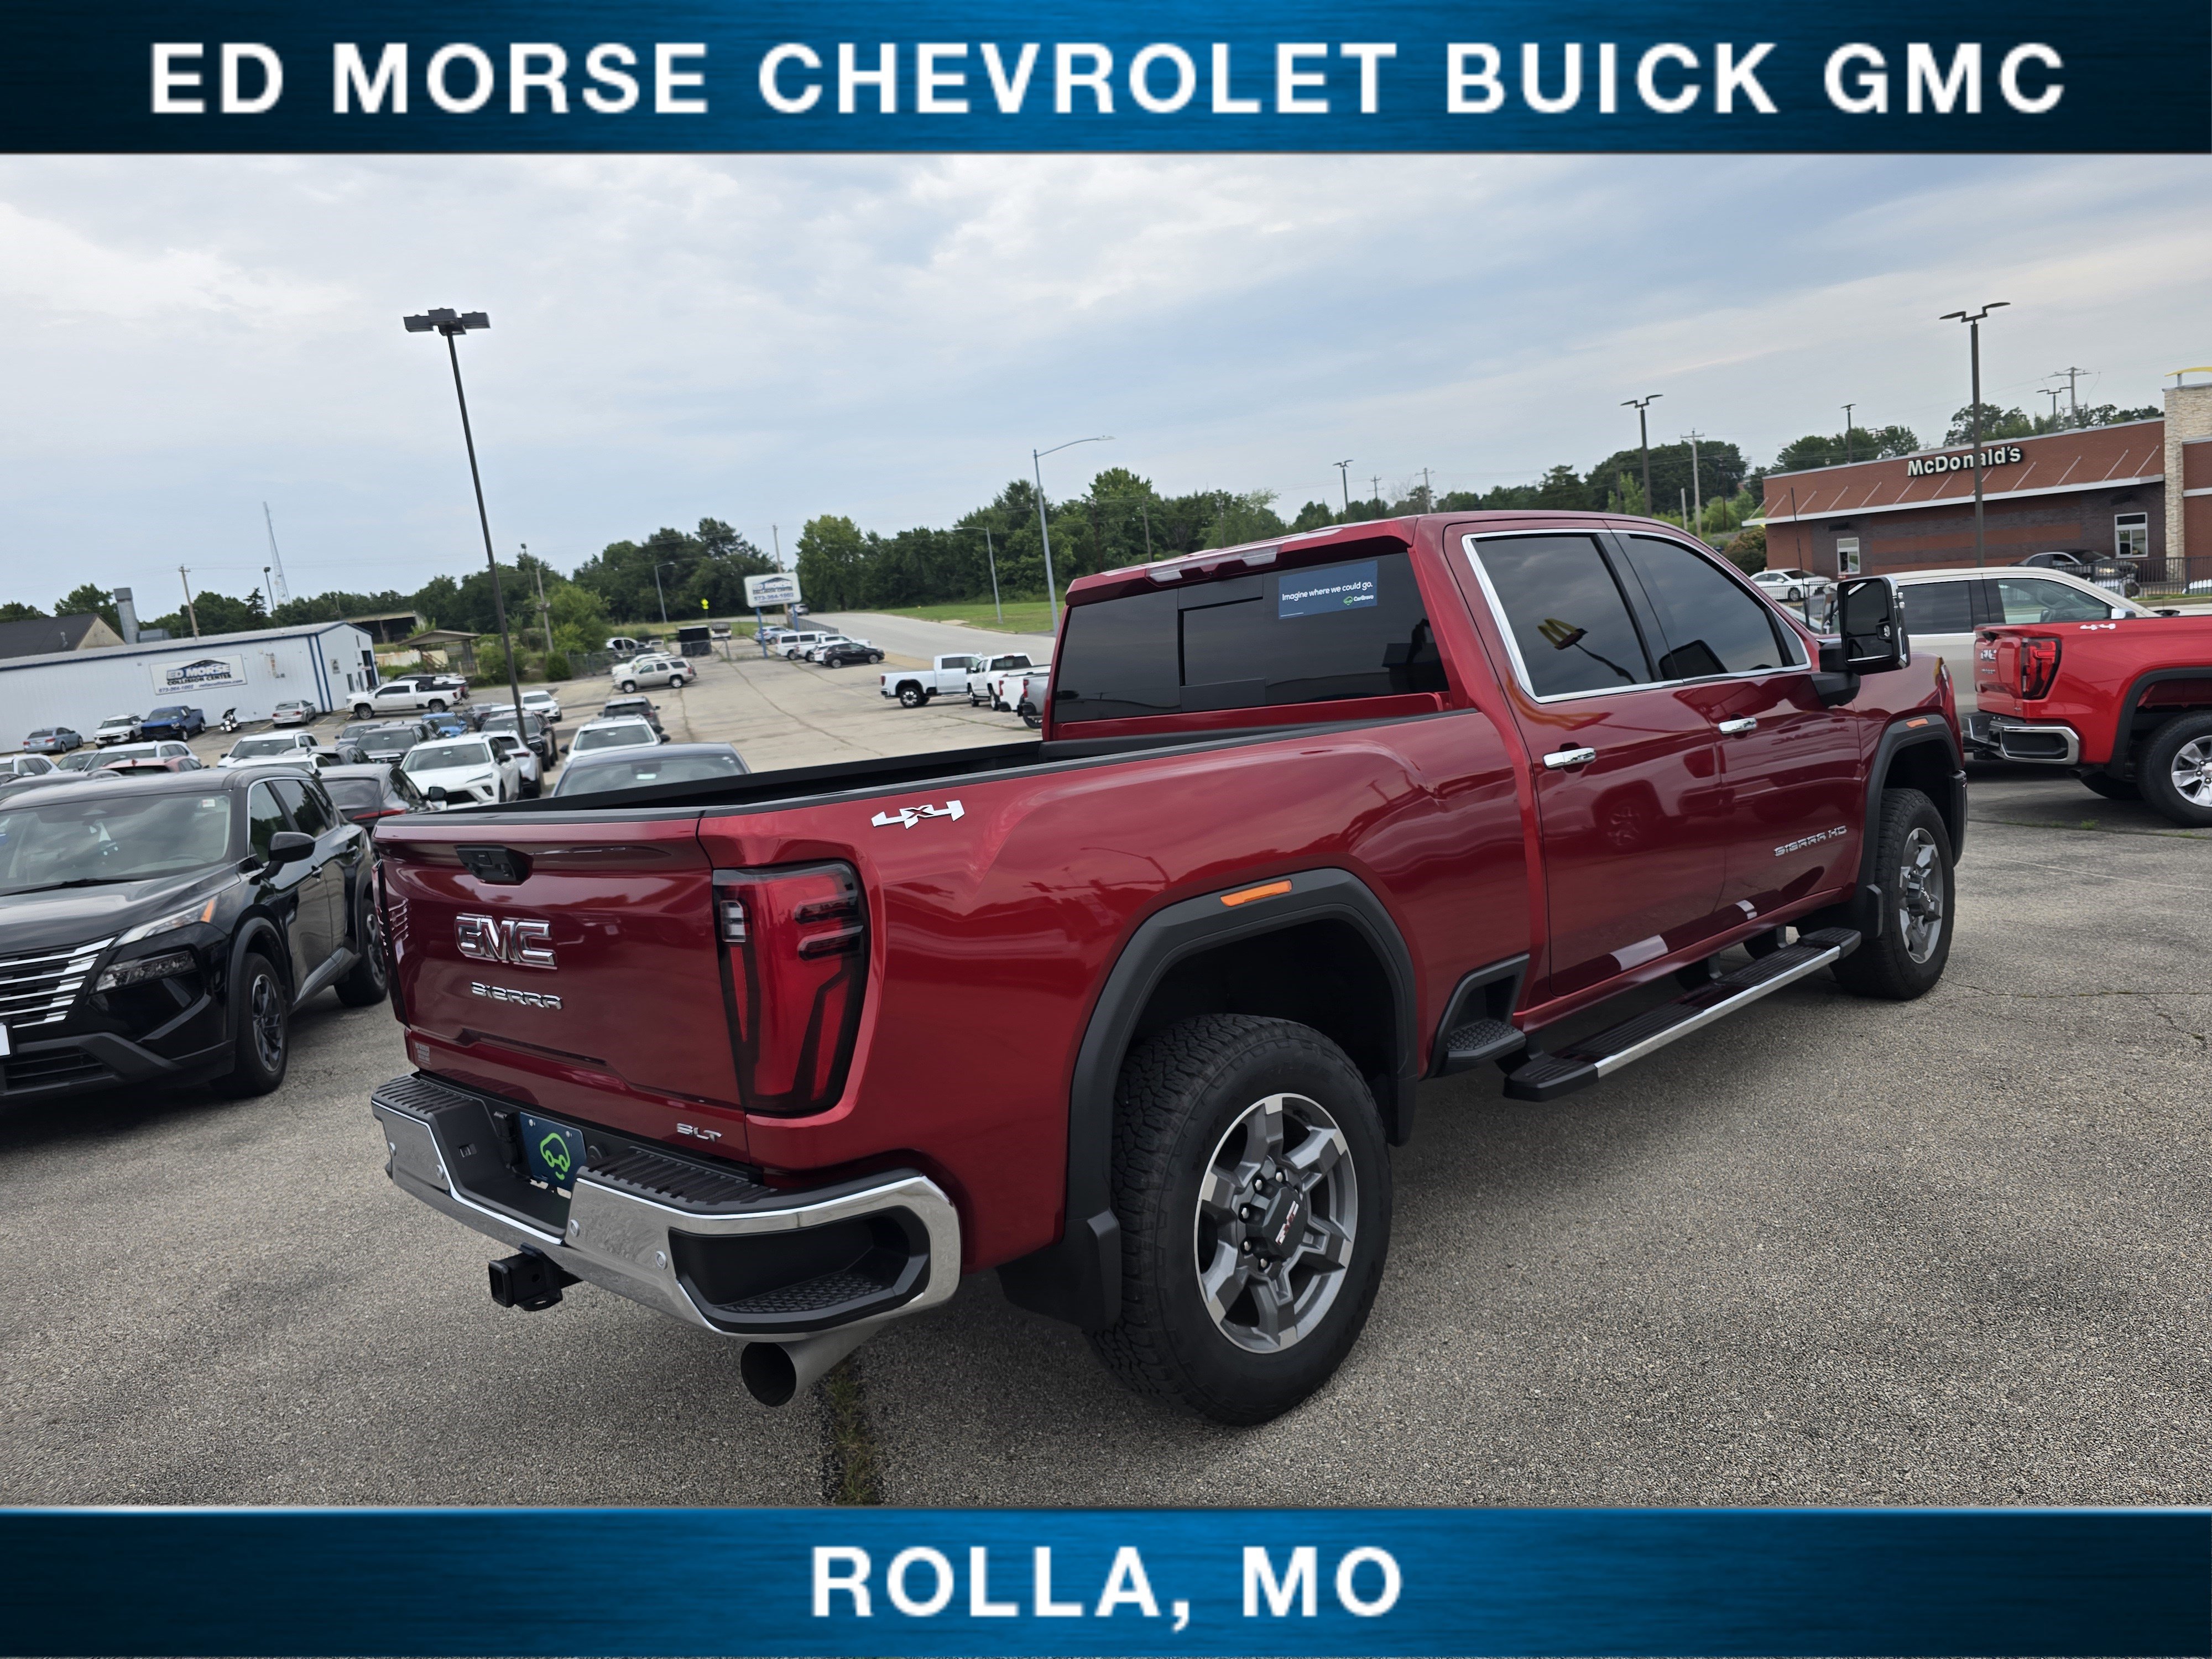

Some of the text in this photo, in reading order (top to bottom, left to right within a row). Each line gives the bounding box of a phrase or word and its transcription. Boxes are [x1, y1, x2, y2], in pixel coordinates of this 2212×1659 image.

[1908, 446, 2021, 476] McDonald's
[1282, 591, 1308, 601] Imagine
[1309, 588, 1330, 597] where
[1342, 582, 1361, 592] could
[1362, 581, 1373, 591] go.
[168, 664, 231, 679] ED MORSE
[168, 676, 205, 686] COLLISION
[1774, 825, 1847, 857] SIERRA HD
[455, 914, 556, 967] GMC
[471, 982, 562, 1010] SIERRA
[677, 1123, 722, 1142] SLT
